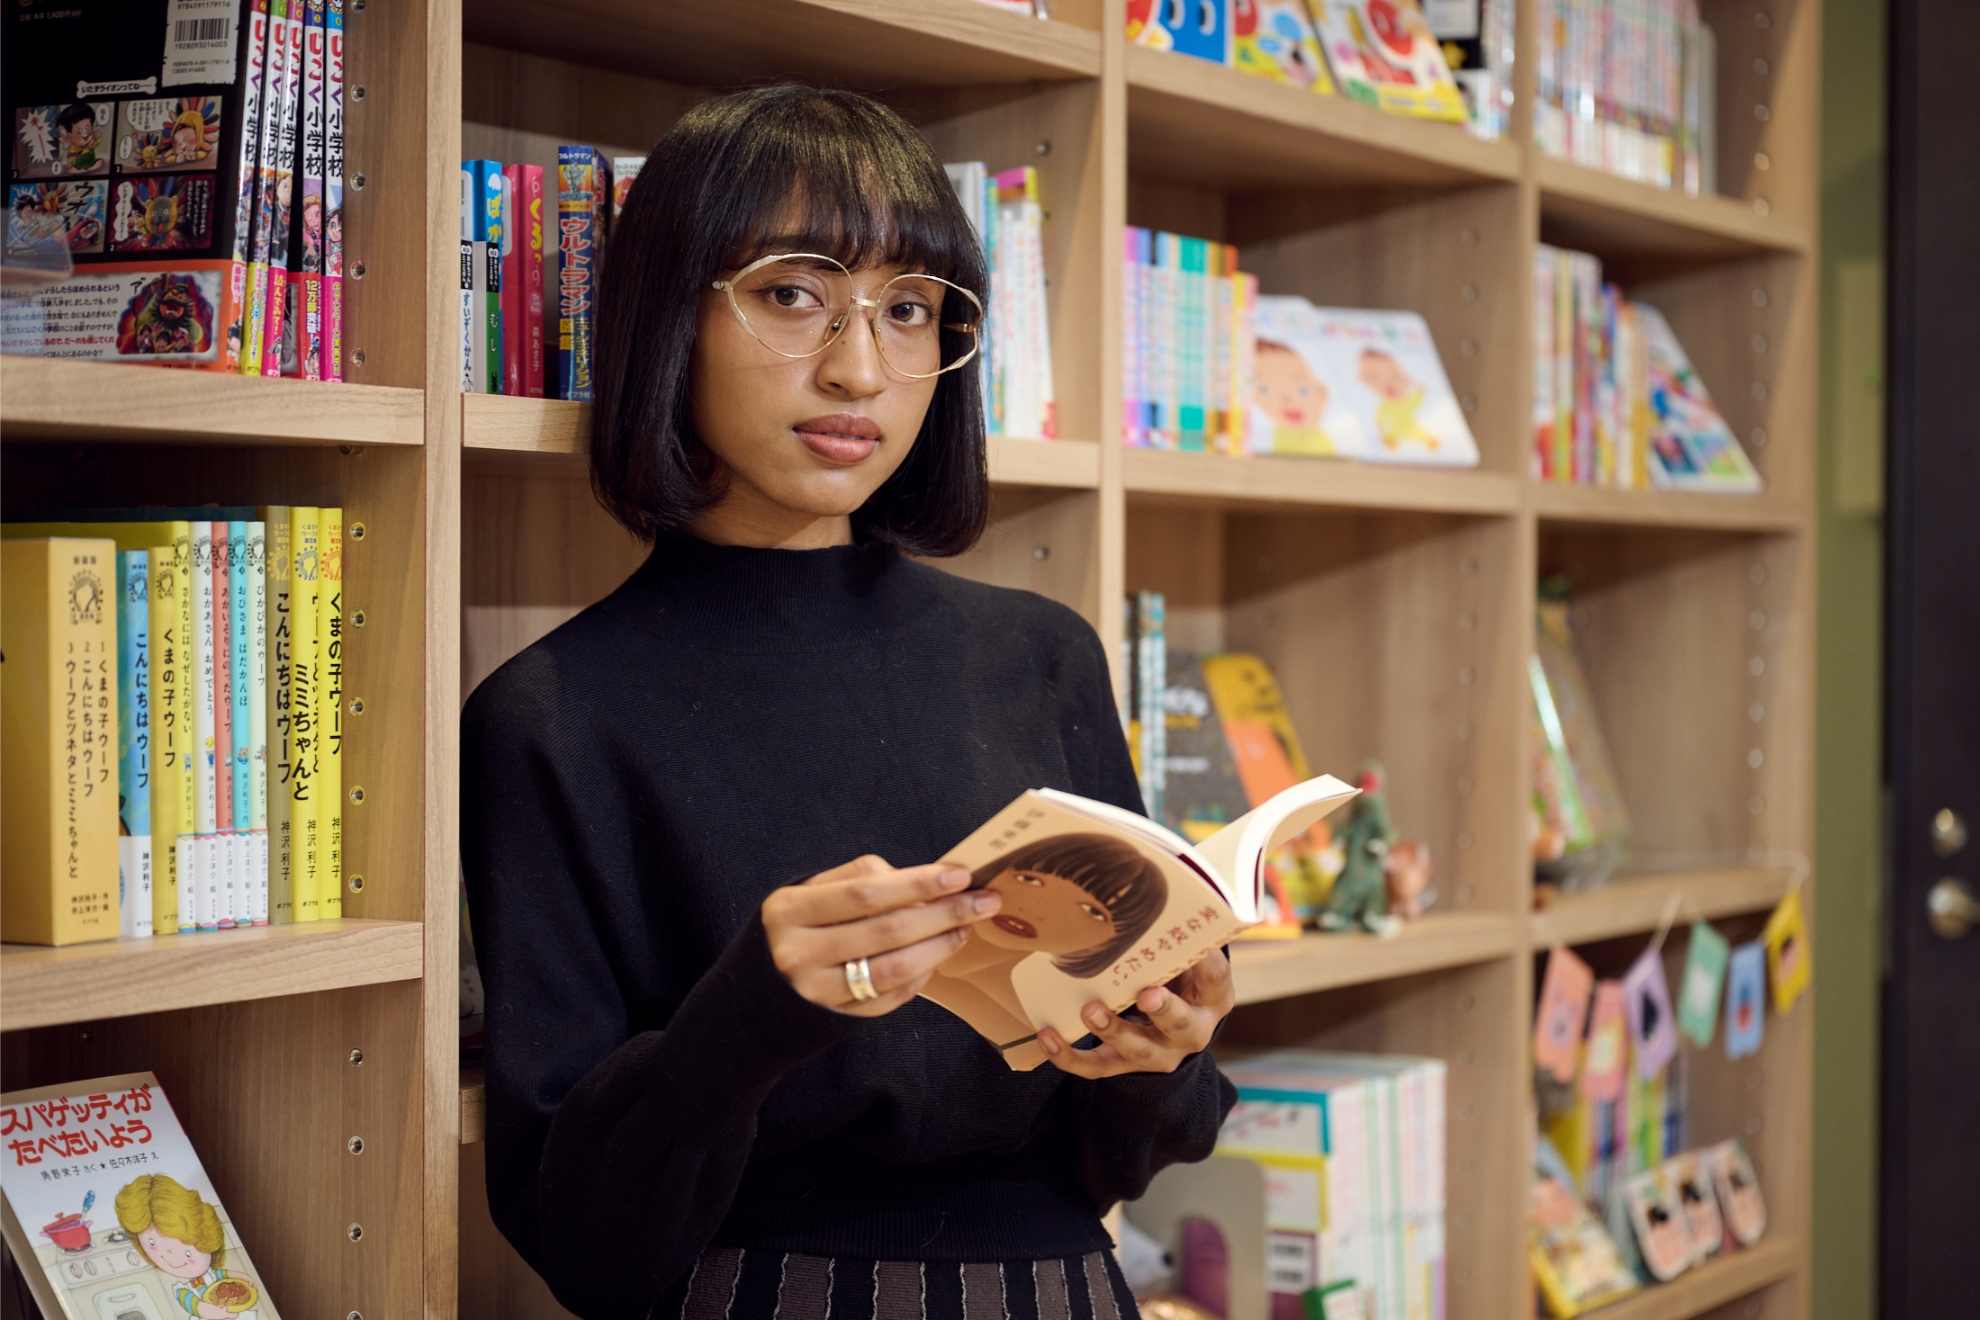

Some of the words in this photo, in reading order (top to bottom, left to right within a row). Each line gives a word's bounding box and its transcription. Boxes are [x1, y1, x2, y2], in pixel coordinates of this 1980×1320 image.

[174, 41, 228, 50] 1928093014003
[560, 217, 591, 316] ウルトラマン
[82, 660, 94, 797] こんにちはウーフ
[98, 660, 109, 782] くまの子ウーフ
[135, 633, 149, 788] こんにちはウーフ
[162, 628, 176, 768] くまの子ウーフ
[275, 592, 290, 784] こんにちはウーフ
[293, 664, 311, 801] ミミちゃんと
[328, 592, 342, 755] くまの子ウーフ
[65, 659, 78, 879] ウーフとツネタとミミちゃんと
[280, 820, 290, 880] 神沢利子
[307, 819, 317, 879] 神沢利子
[332, 816, 341, 878] 神沢利子
[0, 1084, 152, 1136] スパゲッティが
[8, 1119, 152, 1166] たべたいよう
